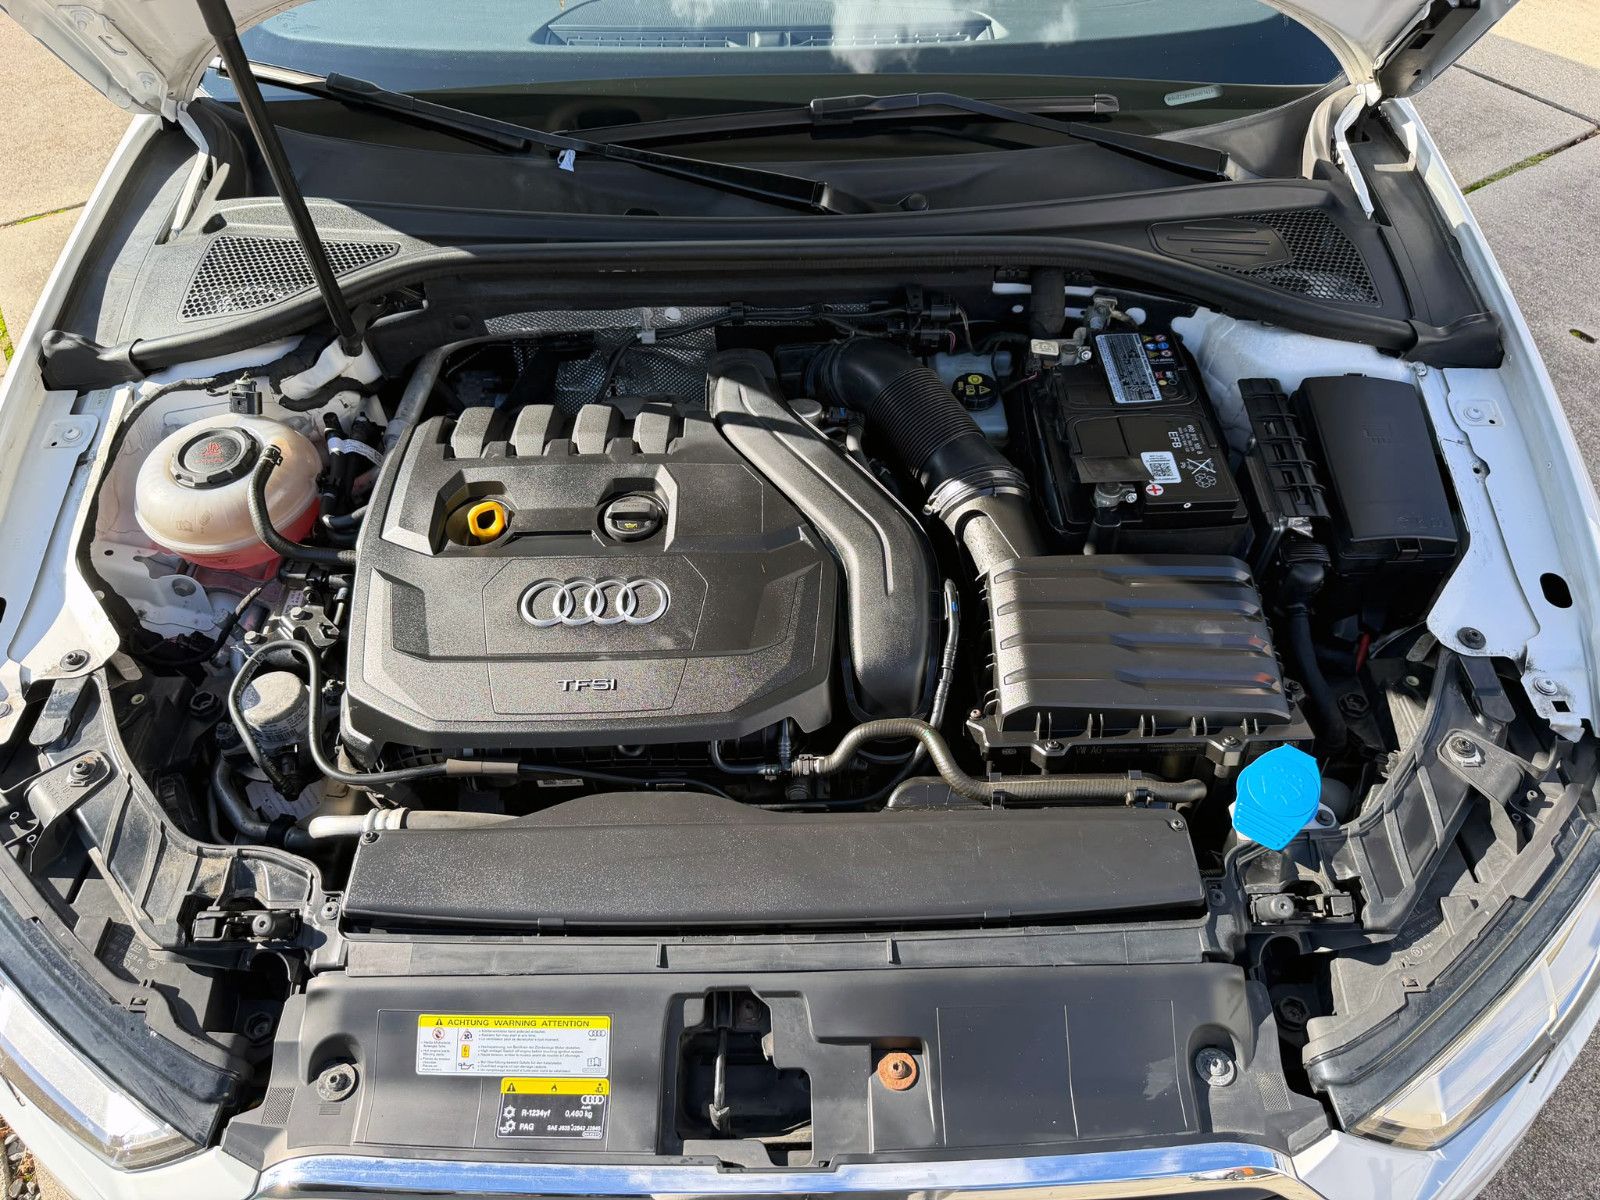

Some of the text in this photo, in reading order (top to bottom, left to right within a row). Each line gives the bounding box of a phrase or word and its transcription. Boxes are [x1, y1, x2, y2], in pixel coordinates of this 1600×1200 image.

[1168, 431, 1182, 448] EFB
[558, 678, 618, 692] TFSI
[1091, 746, 1103, 754] AG
[494, 1019, 537, 1027] WARNING
[521, 1109, 551, 1118] R-1234yf
[584, 1109, 593, 1119] kg
[519, 1123, 535, 1131] PAG
